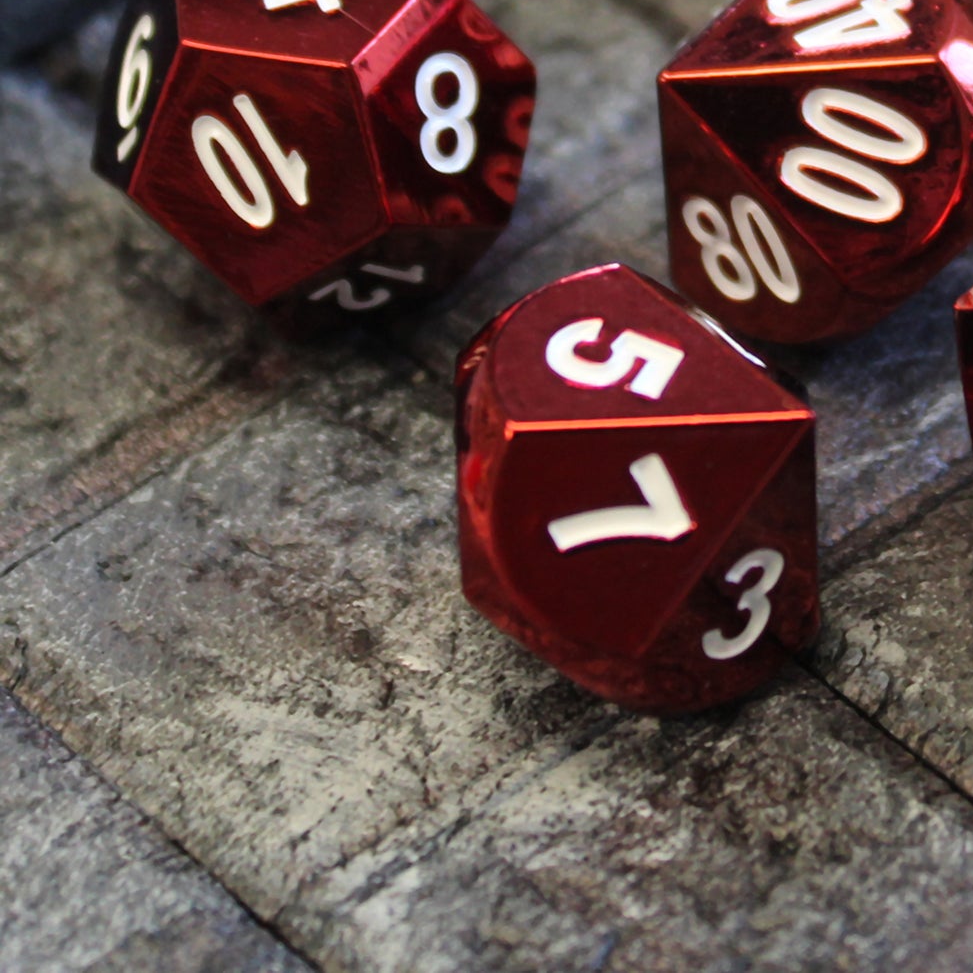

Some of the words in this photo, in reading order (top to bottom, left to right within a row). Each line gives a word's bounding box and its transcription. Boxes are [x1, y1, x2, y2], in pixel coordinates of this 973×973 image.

[191, 93, 308, 228] 10
[415, 53, 478, 173] 8
[780, 88, 927, 222] 00
[309, 263, 424, 310] 12
[683, 194, 800, 304] 80
[545, 318, 684, 399] 5
[548, 453, 696, 553] 7
[702, 548, 784, 660] 3
